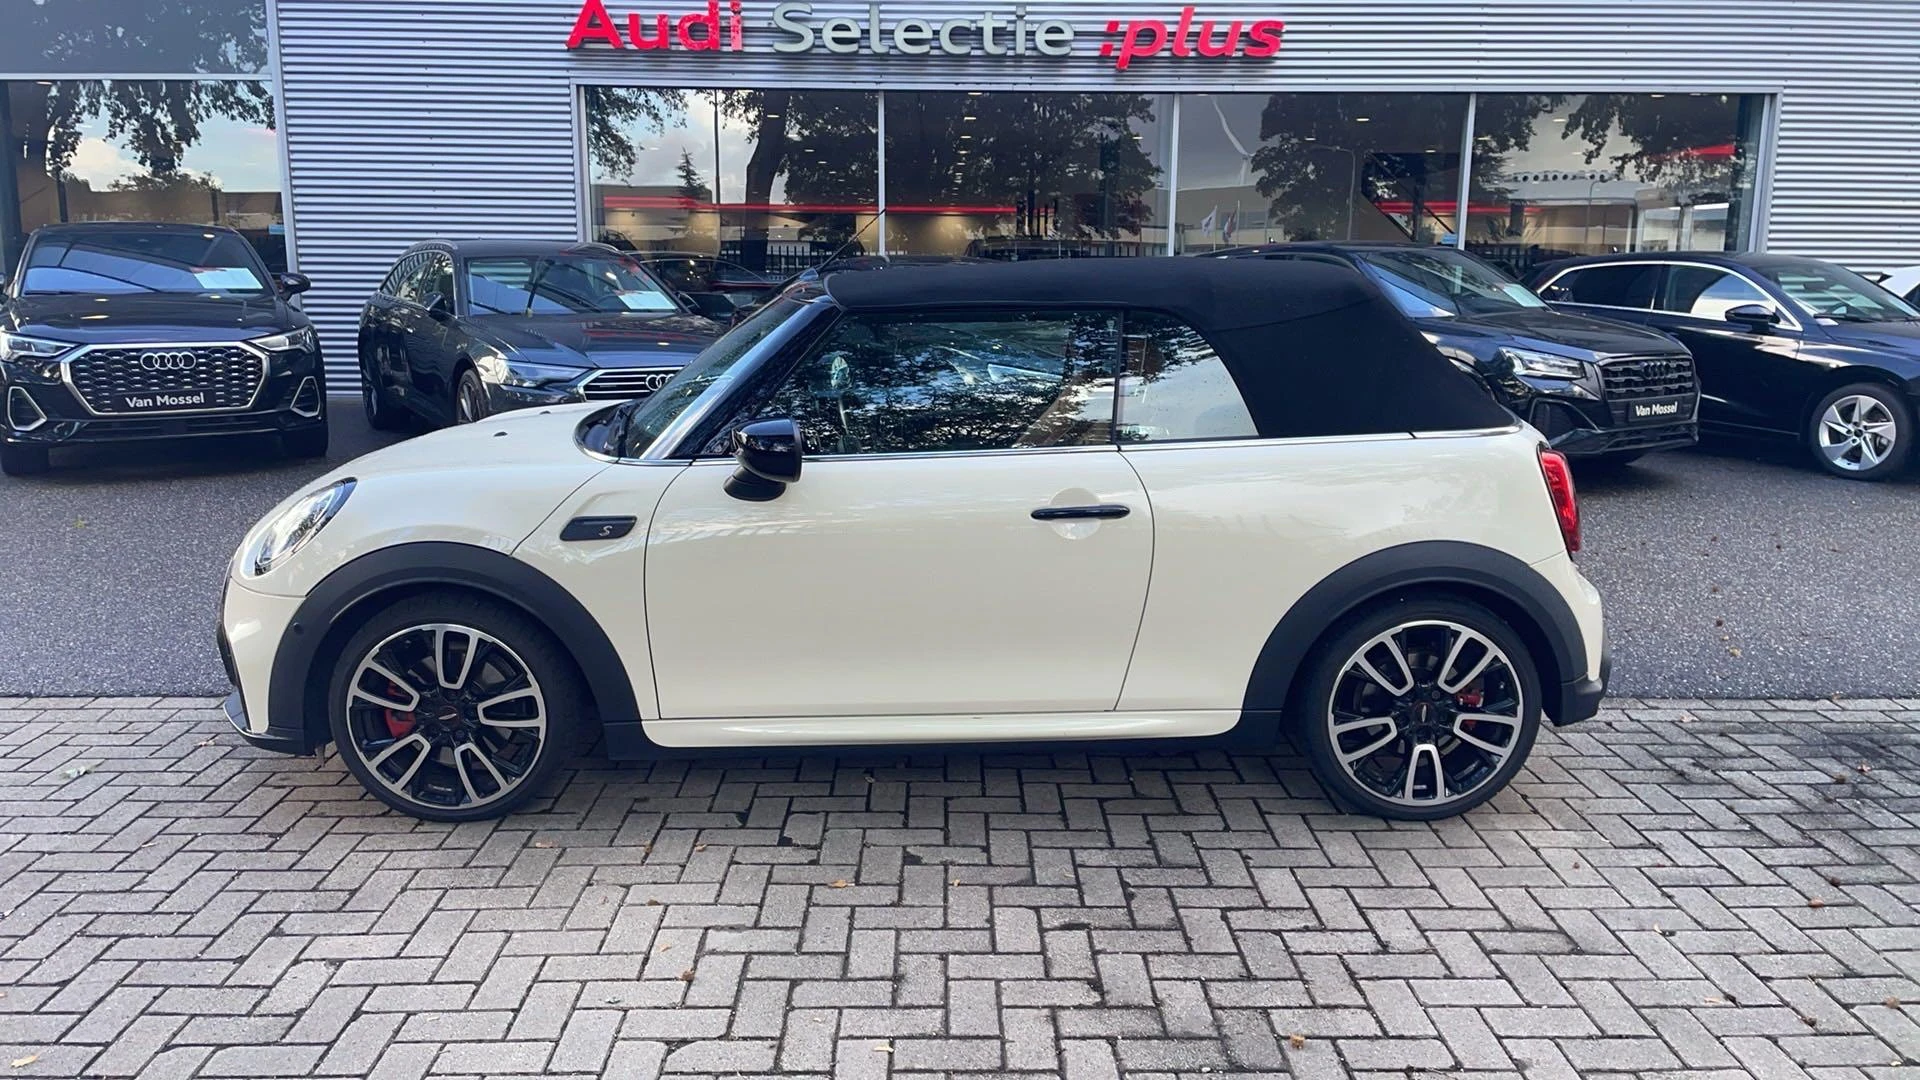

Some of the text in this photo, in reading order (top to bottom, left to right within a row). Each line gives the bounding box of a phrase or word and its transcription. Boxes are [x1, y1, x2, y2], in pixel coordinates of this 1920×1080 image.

[565, 0, 743, 51] Audi
[772, 1, 1075, 56] Selectie
[125, 391, 205, 408] Van Mossel
[1635, 401, 1678, 417] Van Mossel
[598, 525, 613, 537] S
